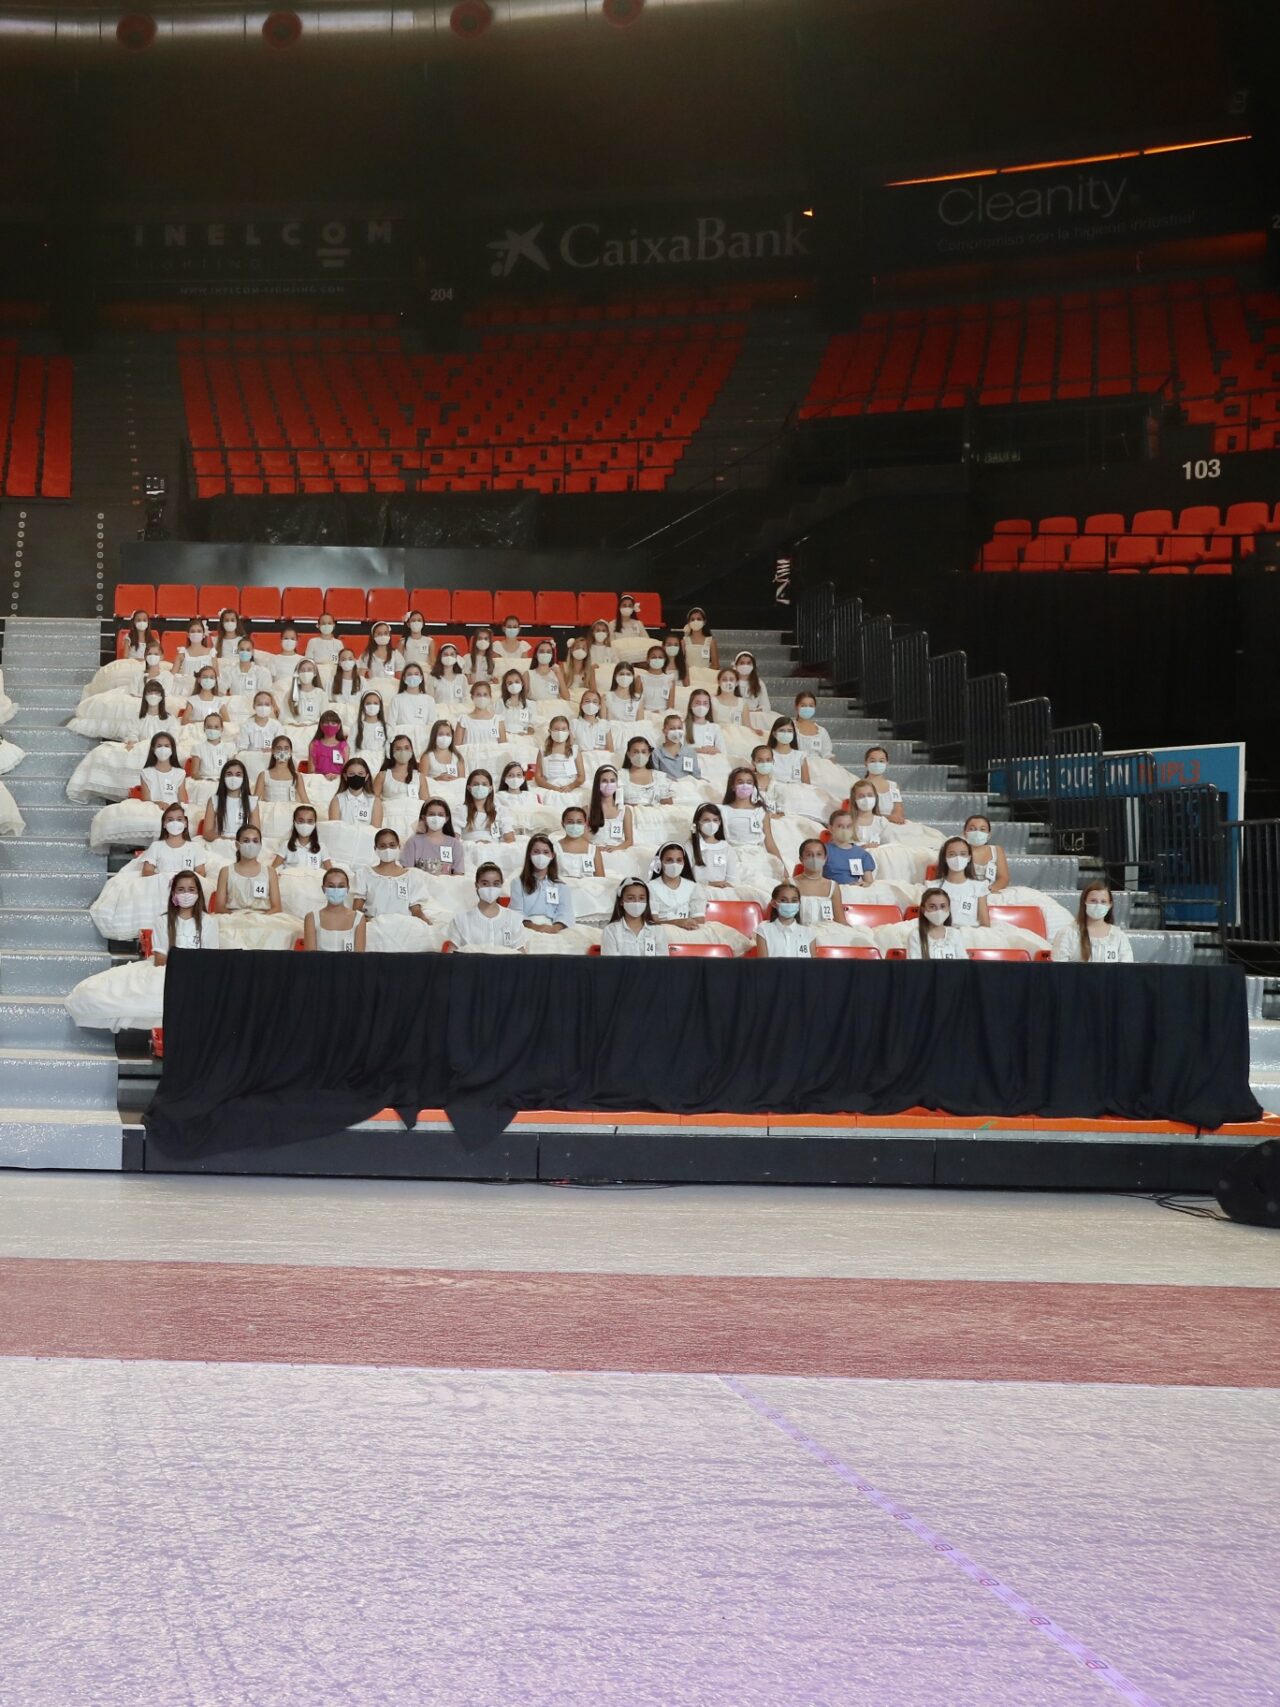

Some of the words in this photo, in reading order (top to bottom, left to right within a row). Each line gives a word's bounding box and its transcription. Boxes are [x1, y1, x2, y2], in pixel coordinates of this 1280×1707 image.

[938, 175, 1127, 226] Cleanity
[561, 213, 811, 268] CaixaBank
[430, 288, 453, 301] 204
[1182, 459, 1221, 480] 103
[400, 886, 406, 894] 35
[824, 906, 830, 914] 22
[646, 944, 654, 952] 24
[799, 945, 808, 953] 48
[1107, 951, 1116, 960] 20
